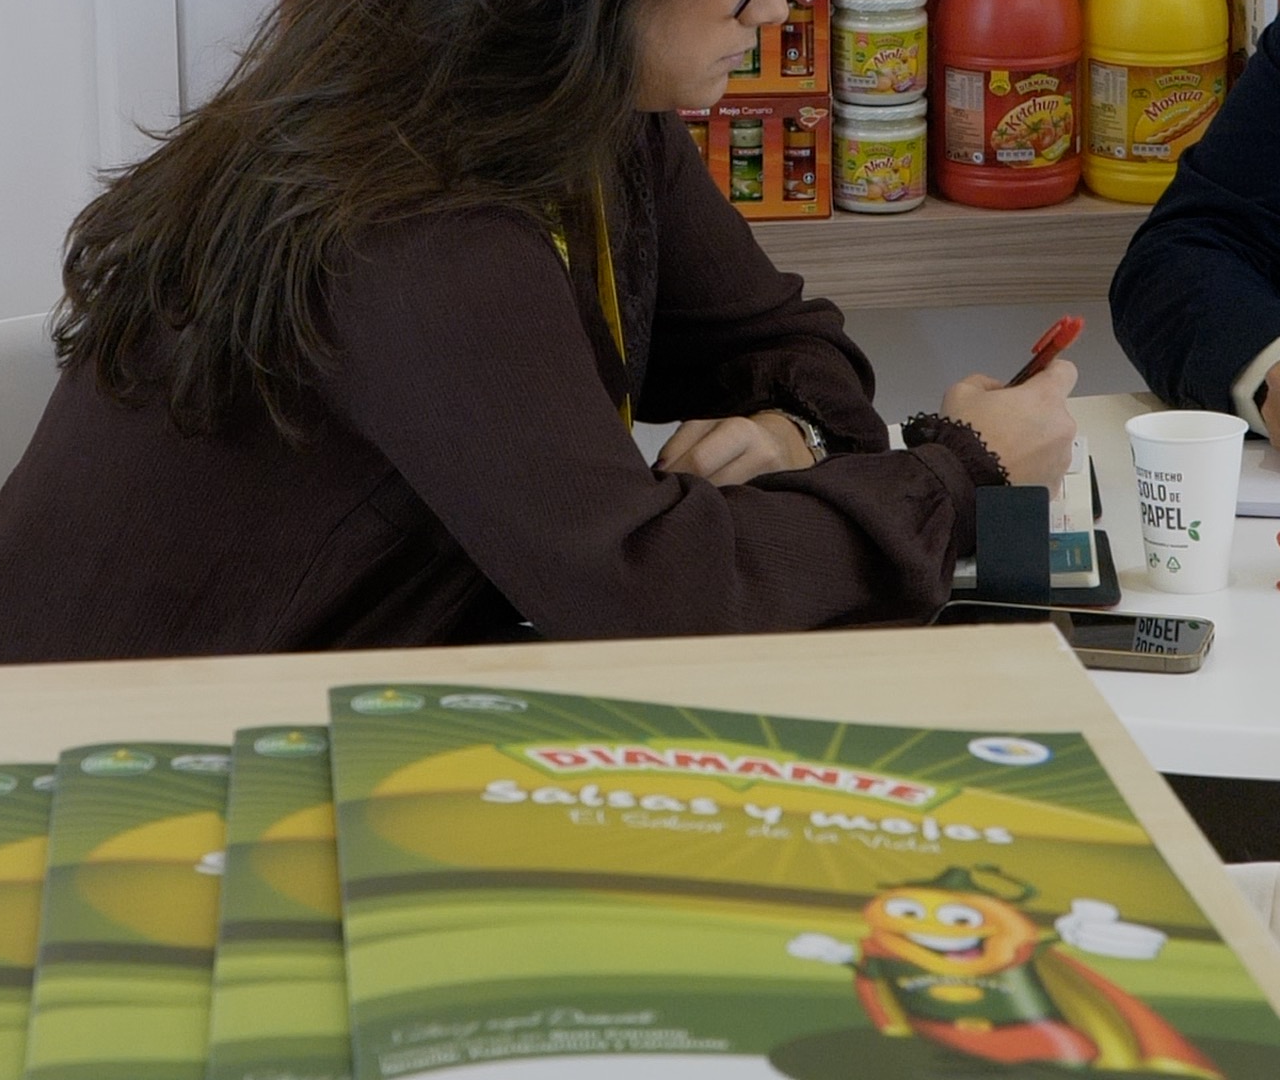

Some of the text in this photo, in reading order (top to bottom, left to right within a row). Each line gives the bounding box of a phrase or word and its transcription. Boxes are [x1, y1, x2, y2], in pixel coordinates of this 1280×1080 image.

[873, 48, 904, 68] Alioli
[1005, 98, 1059, 131] Ketchup
[1144, 90, 1204, 122] Mostaza
[864, 158, 894, 177] Alioli
[1138, 479, 1181, 503] SOLO DE
[1154, 472, 1183, 482] HECHO
[1140, 502, 1187, 530] PAPEL
[535, 746, 936, 804] DIAMANTE
[481, 779, 1013, 844] Salsas y mojos
